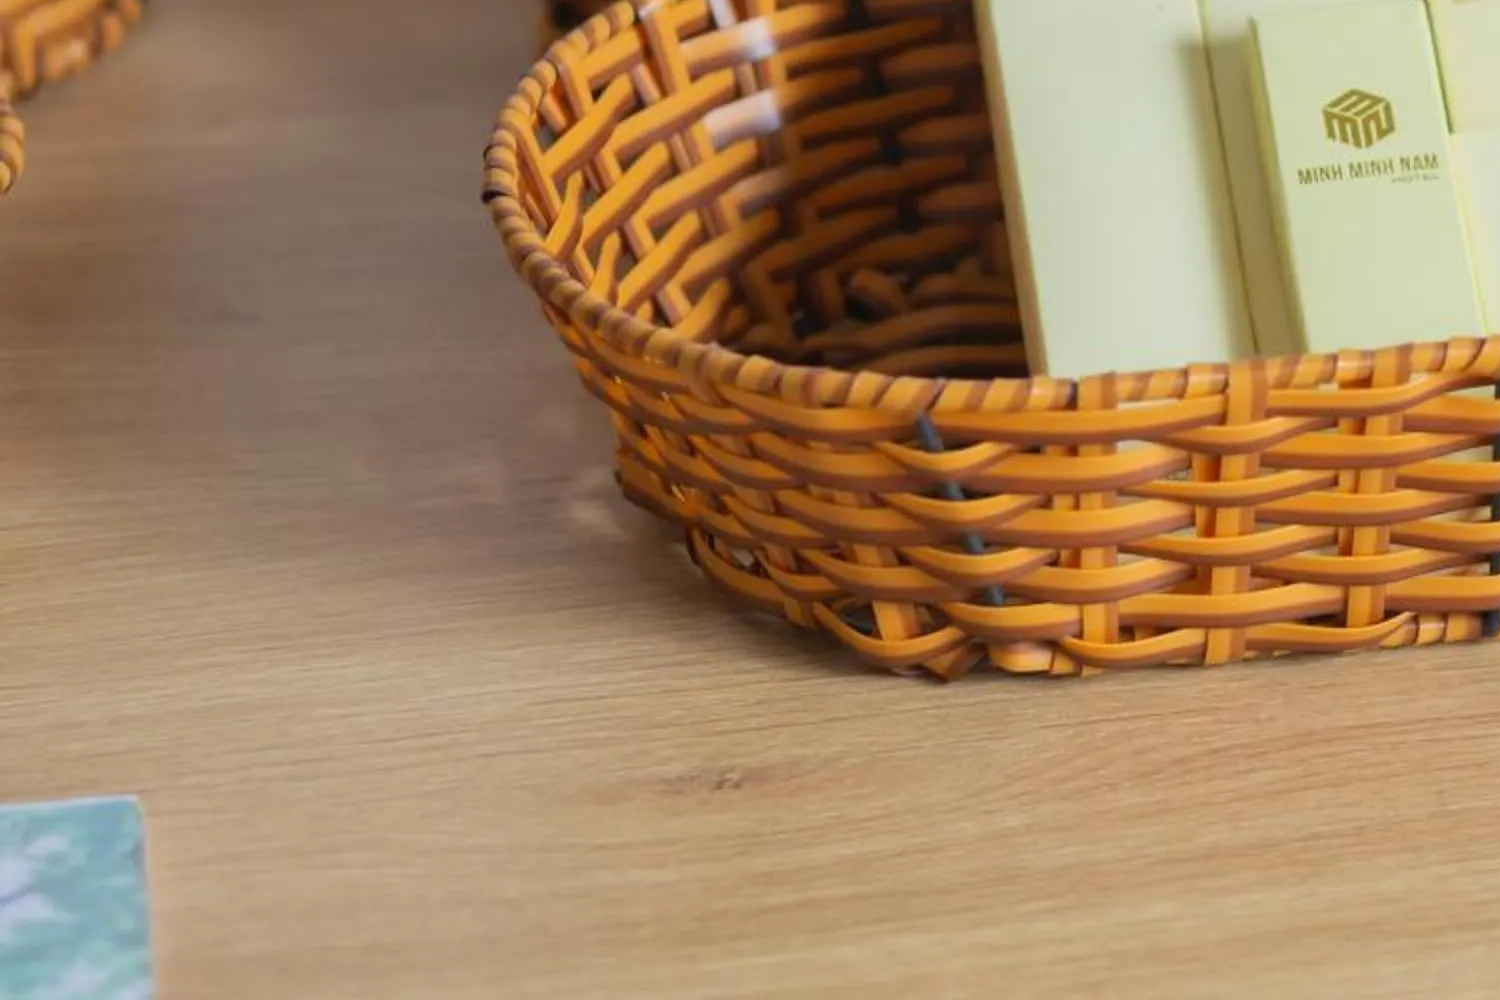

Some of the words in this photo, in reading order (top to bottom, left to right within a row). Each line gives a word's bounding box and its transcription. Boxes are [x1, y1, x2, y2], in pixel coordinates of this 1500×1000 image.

[1297, 163, 1343, 185] MINH
[1348, 158, 1395, 179] MINH
[1399, 152, 1439, 171] NAM
